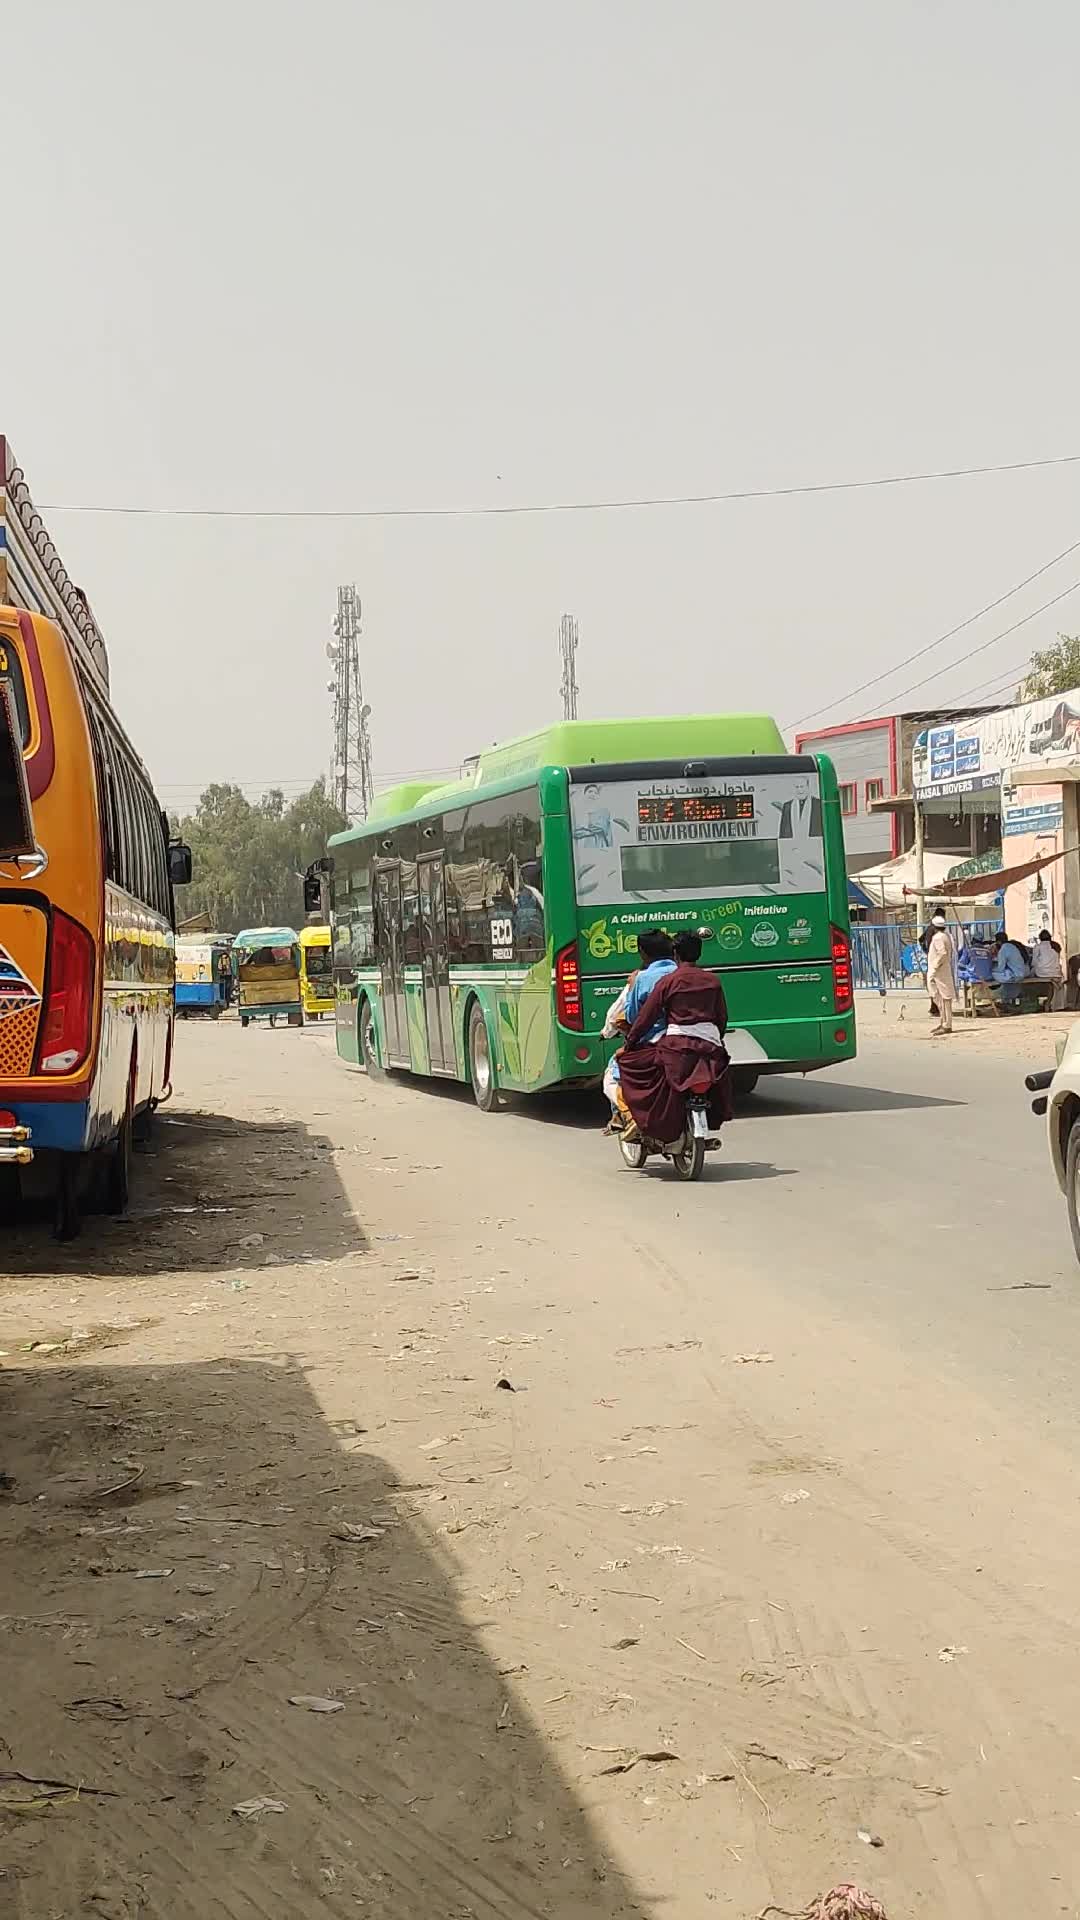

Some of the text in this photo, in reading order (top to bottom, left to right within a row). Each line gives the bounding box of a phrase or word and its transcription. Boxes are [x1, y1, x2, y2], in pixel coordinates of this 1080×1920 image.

[916, 785, 941, 800] FAISAL
[942, 780, 973, 795] MOVERS
[637, 821, 759, 841] ENVIRONMENT
[611, 900, 788, 925] A Chief Minister's Green Initiative
[490, 919, 513, 945] ECO
